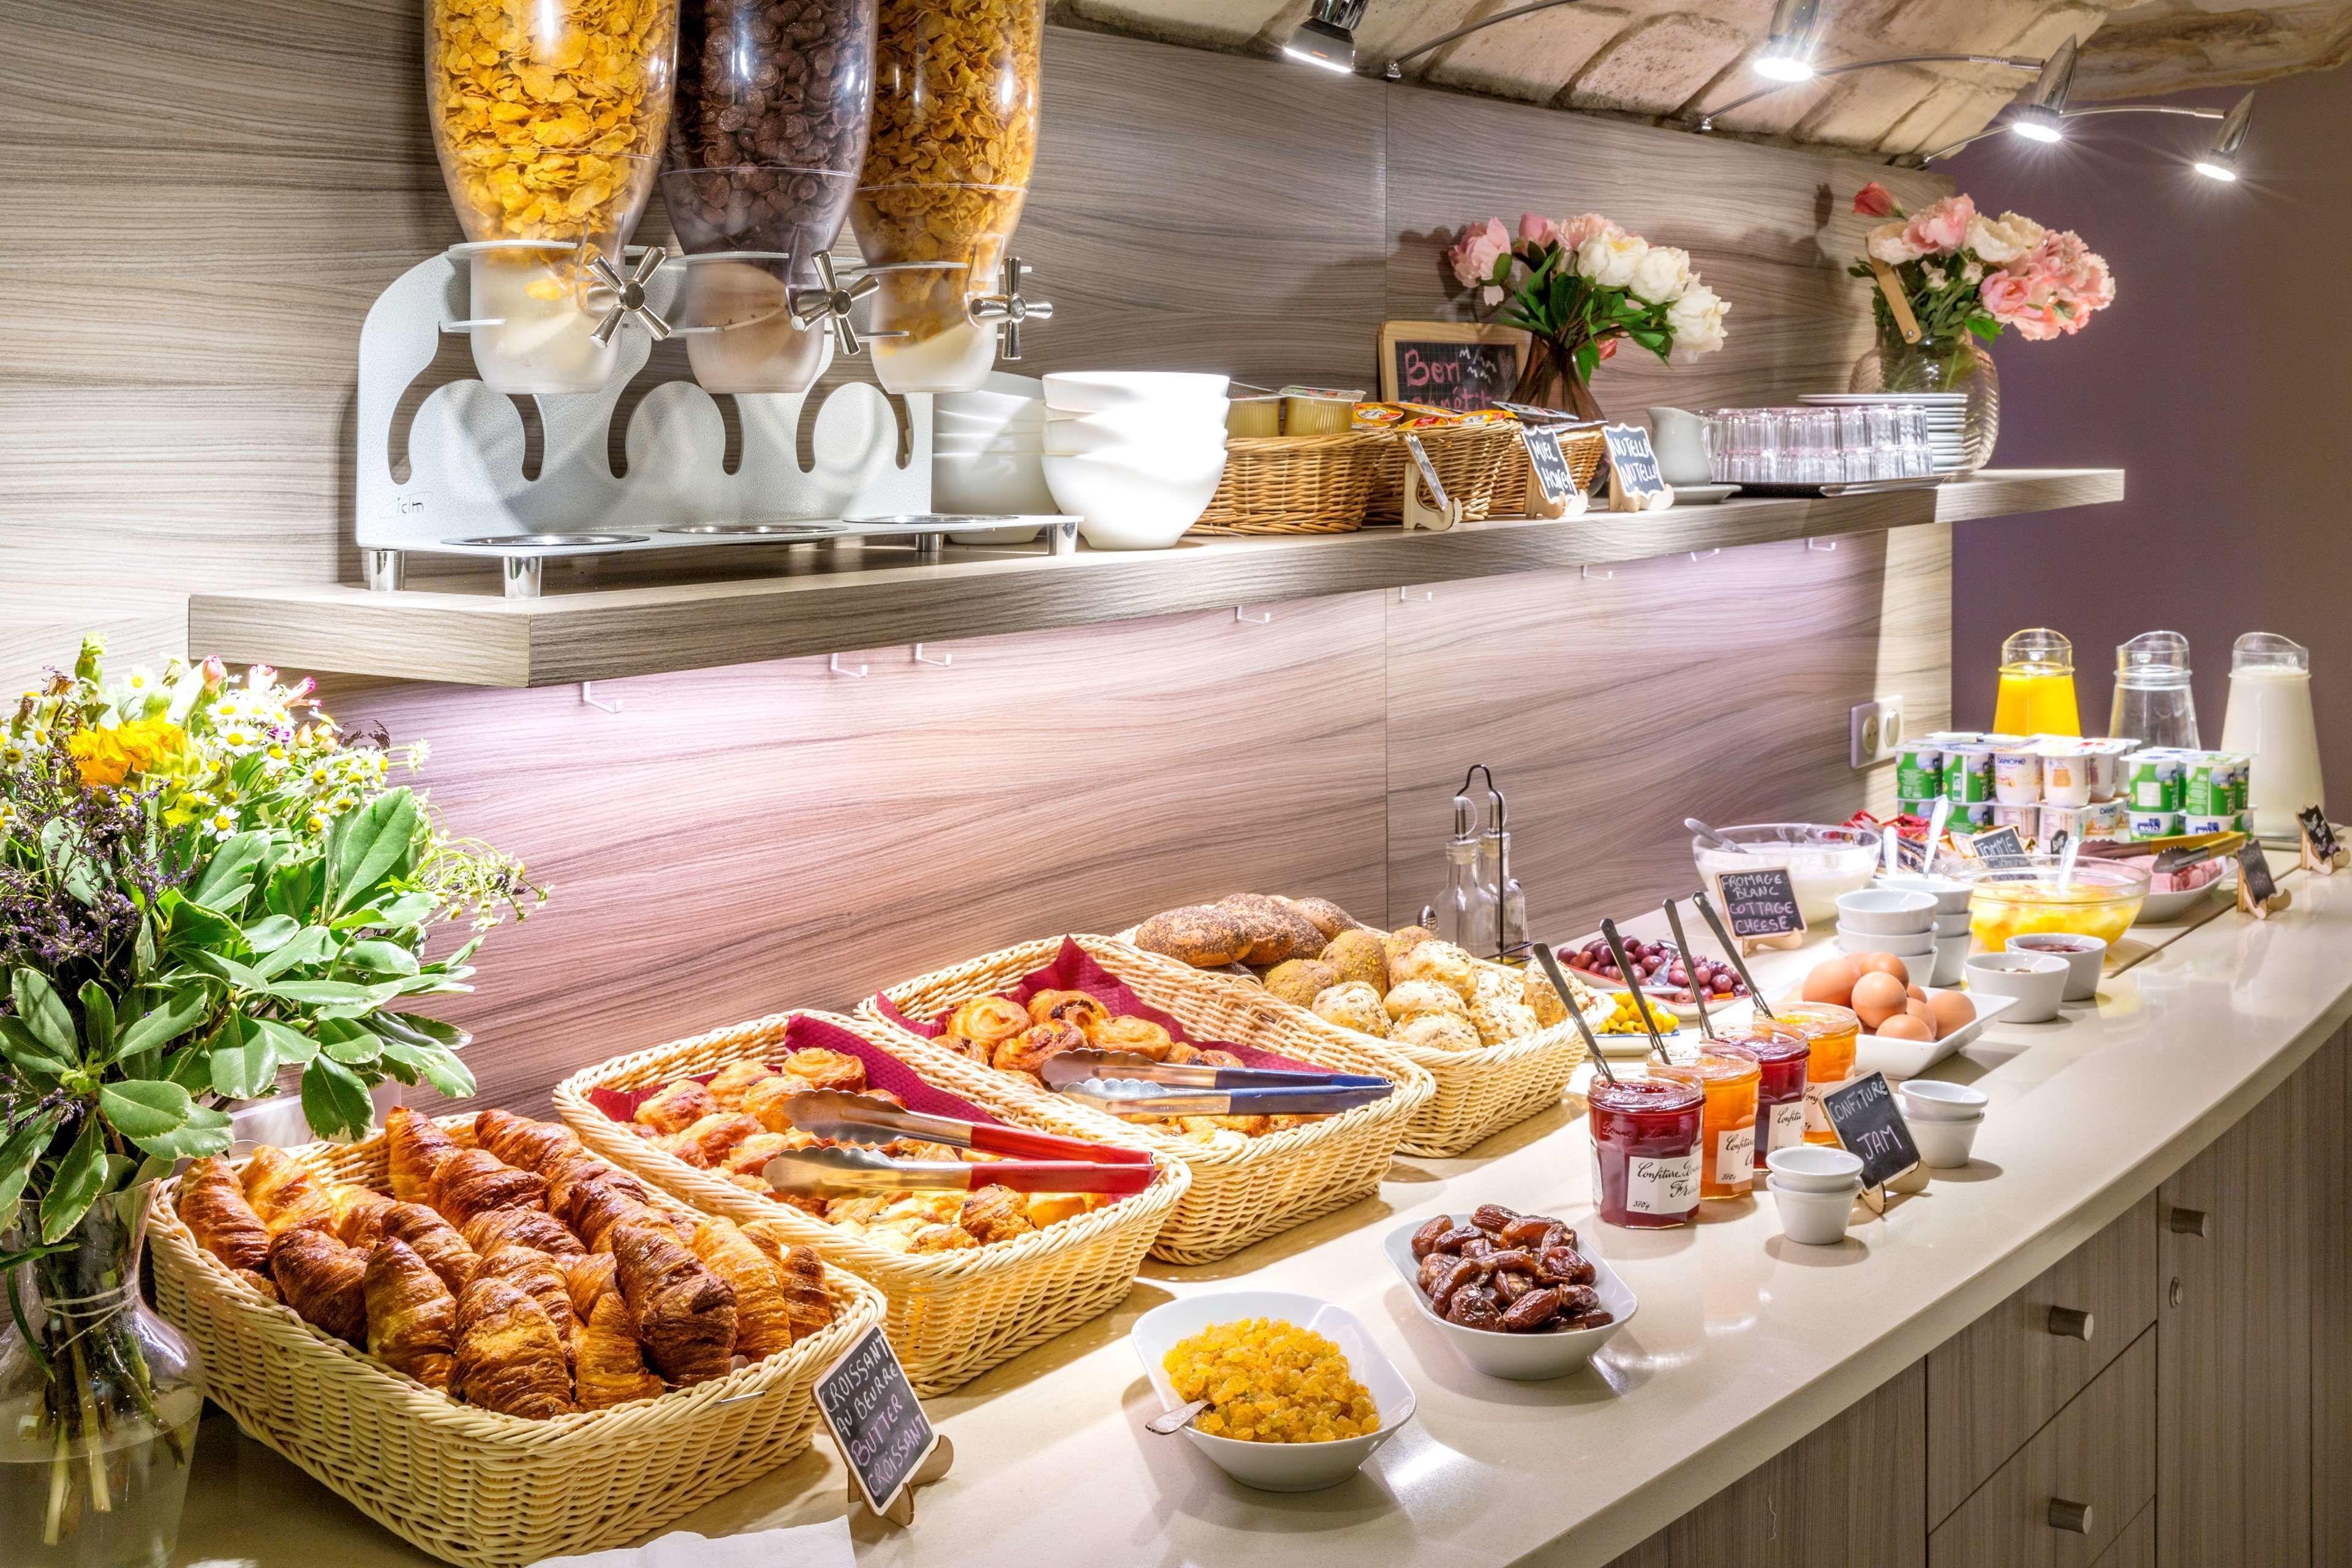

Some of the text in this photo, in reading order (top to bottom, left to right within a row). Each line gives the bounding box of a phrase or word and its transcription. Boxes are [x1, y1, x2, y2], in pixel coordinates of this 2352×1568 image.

[1404, 349, 1460, 386] Bon
[1530, 439, 1558, 462] MIEL
[1609, 437, 1653, 458] NUTELLA
[1619, 462, 1660, 488] NUTELLA
[1975, 835, 2016, 859] TOMME
[1721, 874, 1783, 890] FROMAGE
[1732, 886, 1779, 900] BLANC
[1729, 902, 1794, 916] COTTAGE
[1735, 916, 1790, 934] CHEESE
[1856, 1125, 1903, 1161] JAM
[1637, 1161, 1681, 1183] Confiture
[1633, 1200, 1650, 1210] 370g
[821, 1334, 889, 1413] CROISSANT
[837, 1363, 899, 1438] AU BEURRE
[851, 1394, 902, 1467] BUTTER
[867, 1413, 927, 1497] CROISSANT
